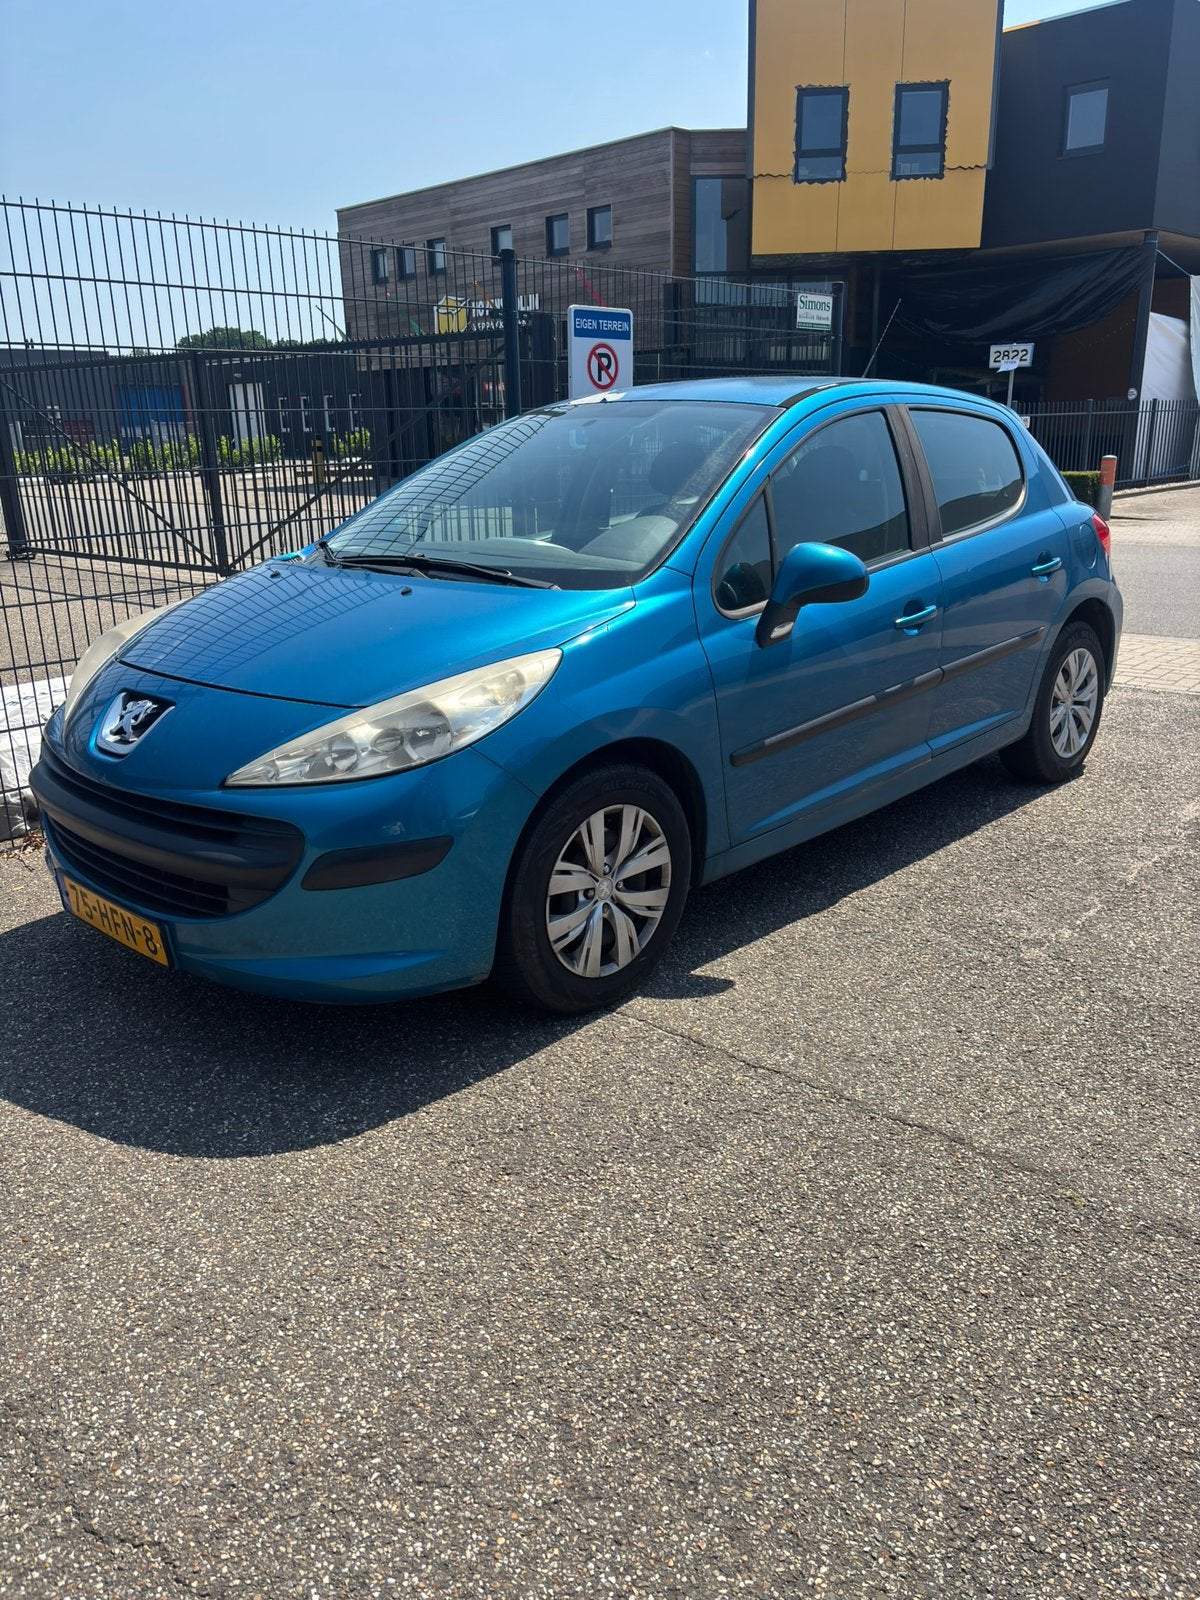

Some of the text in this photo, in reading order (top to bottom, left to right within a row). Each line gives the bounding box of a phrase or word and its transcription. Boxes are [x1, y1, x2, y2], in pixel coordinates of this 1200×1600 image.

[800, 295, 830, 312] Simons
[575, 318, 629, 331] EIGEN TERREIN
[993, 349, 1028, 363] 2822
[69, 883, 158, 955] 75-HFN-8
